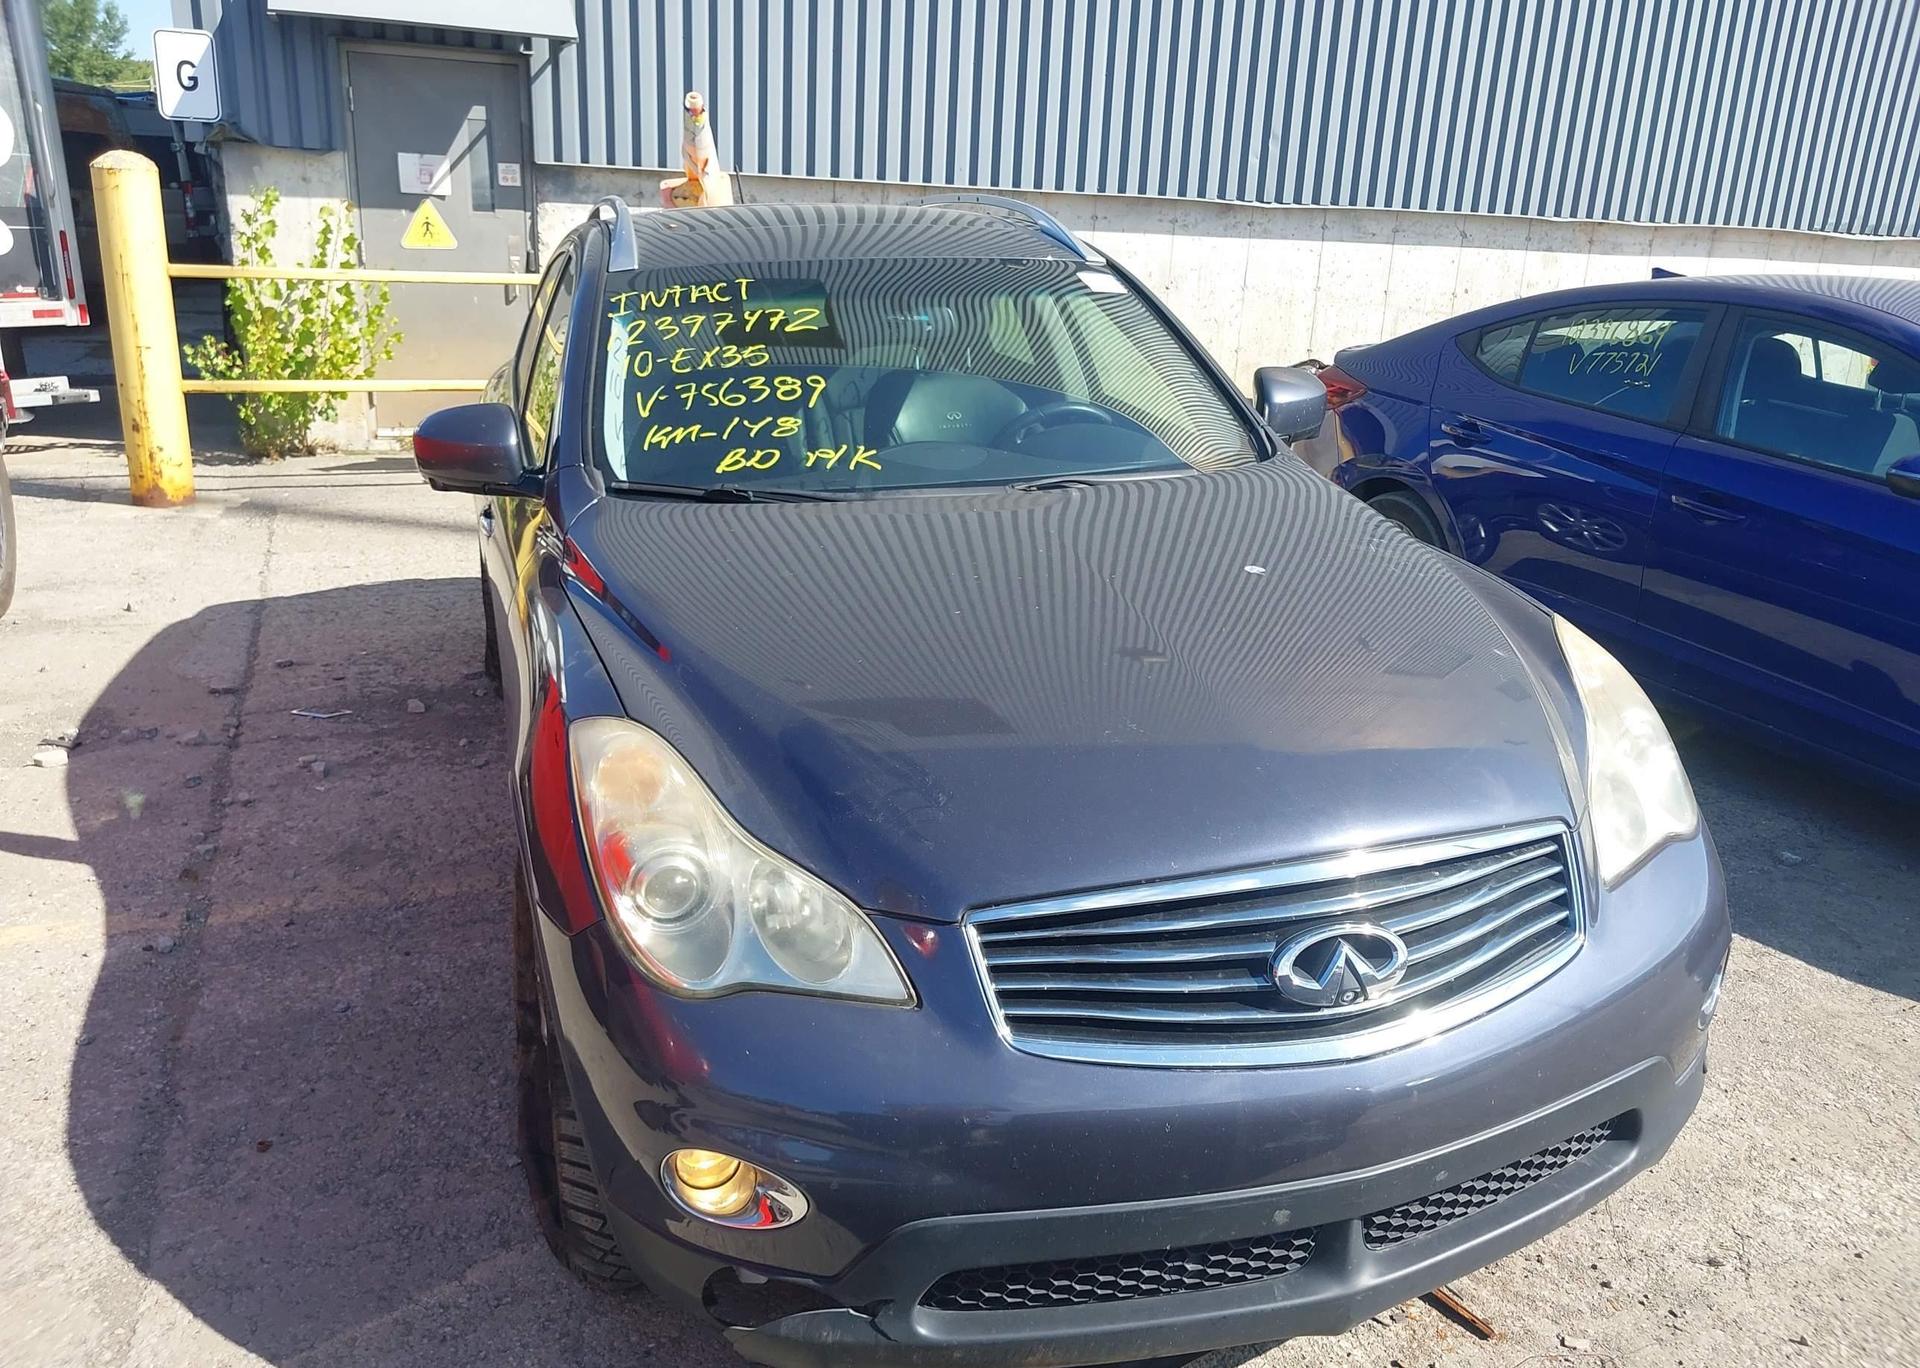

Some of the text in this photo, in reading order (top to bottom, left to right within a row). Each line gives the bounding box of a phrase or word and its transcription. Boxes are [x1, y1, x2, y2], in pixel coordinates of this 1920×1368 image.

[176, 60, 199, 92] G
[608, 278, 755, 318] INTACT
[636, 375, 827, 418] V-756389
